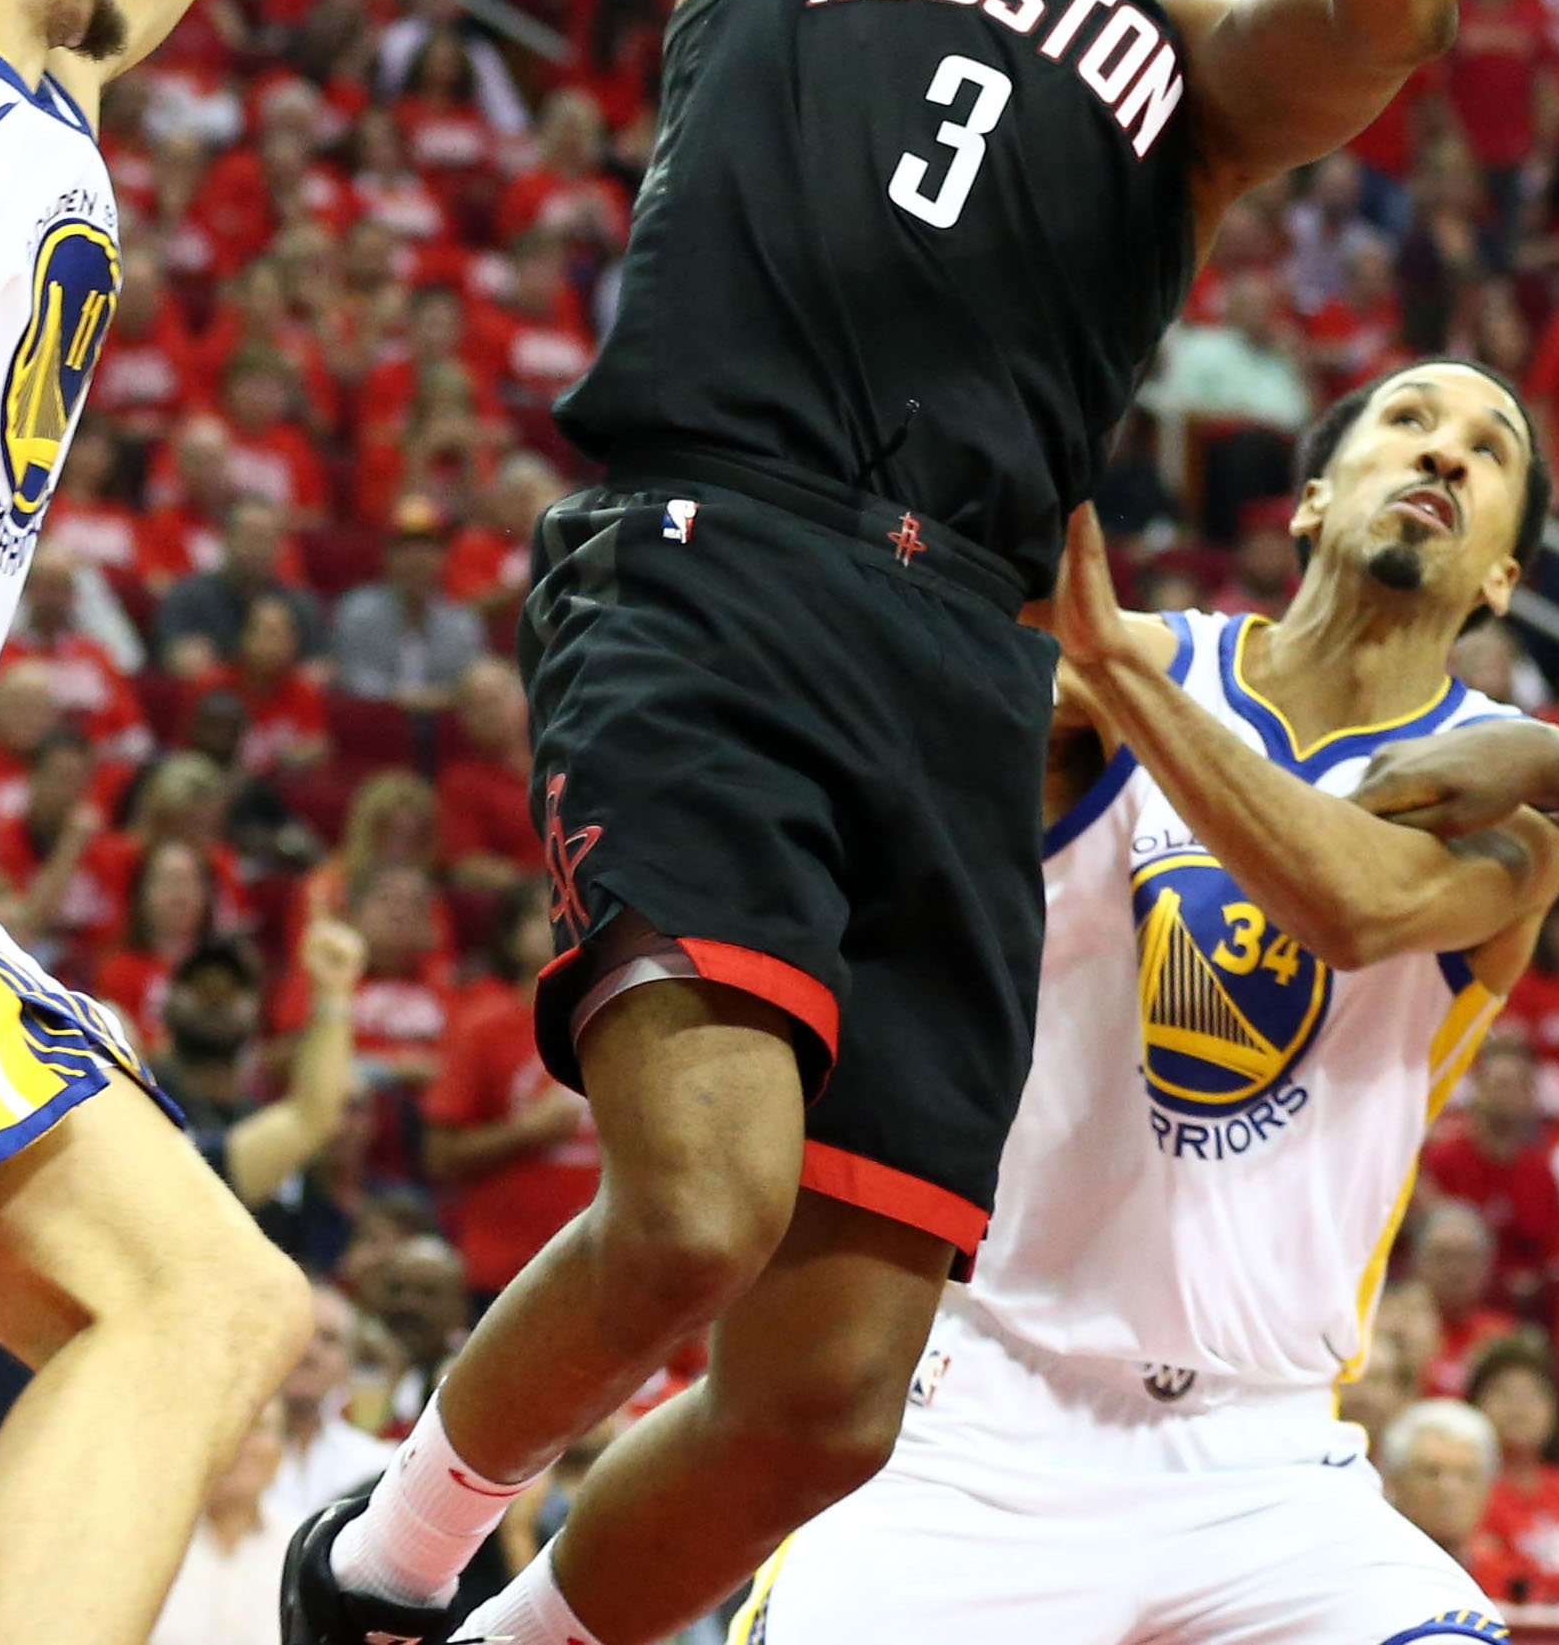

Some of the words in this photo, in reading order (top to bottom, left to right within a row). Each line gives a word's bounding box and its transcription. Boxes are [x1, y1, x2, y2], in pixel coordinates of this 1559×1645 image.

[887, 53, 1014, 230] 3
[1211, 902, 1301, 987] 34
[1147, 1086, 1311, 1161] RRIORS
